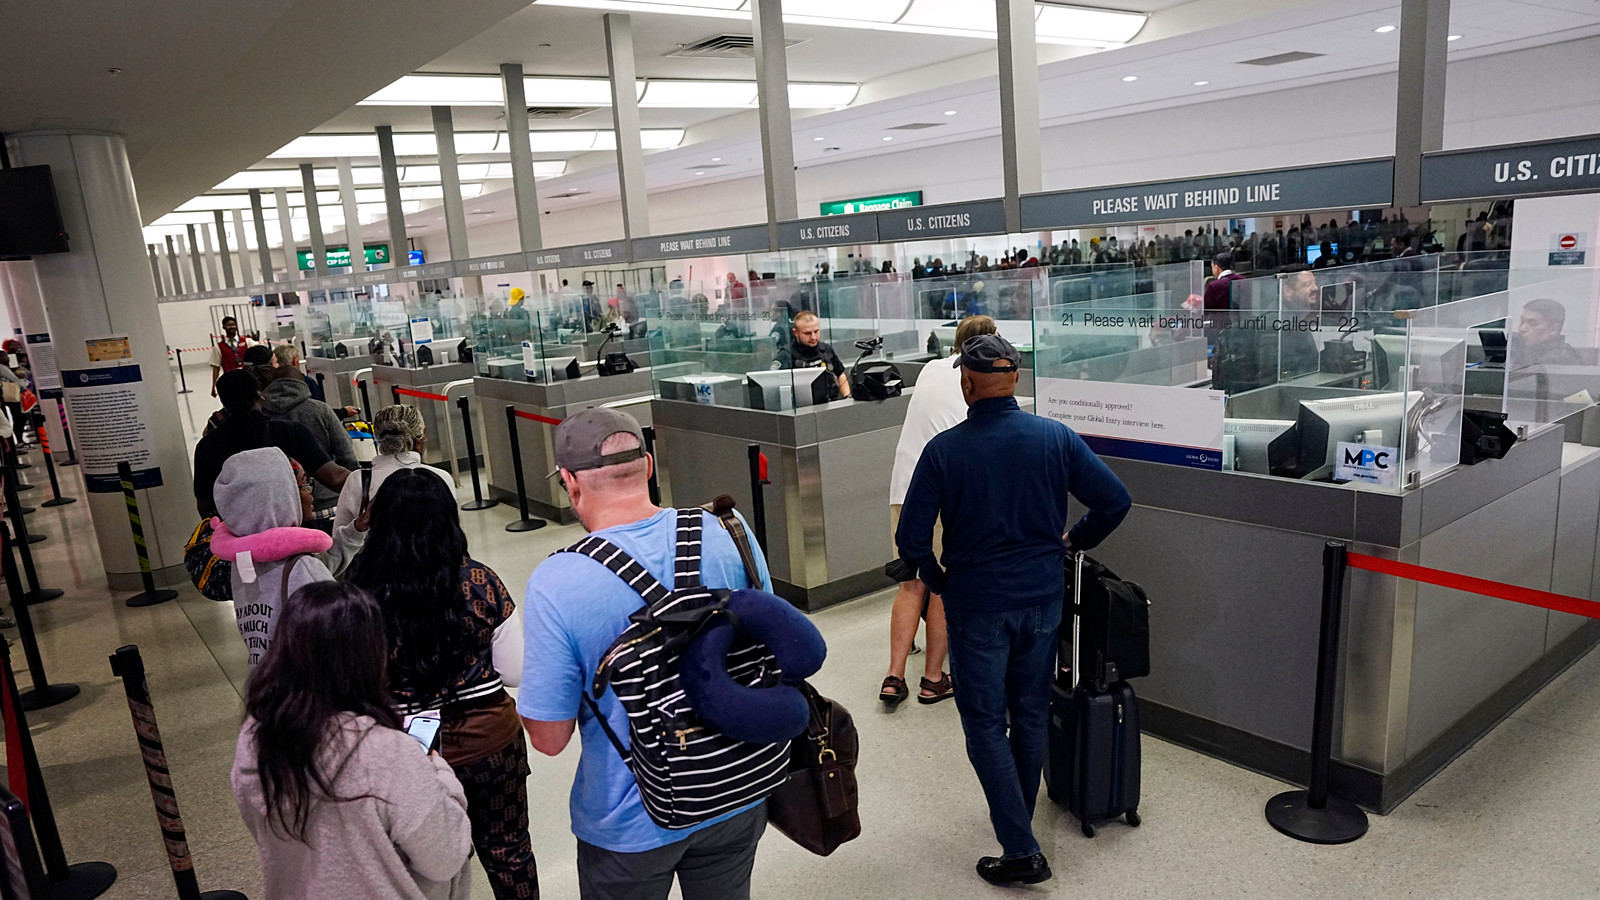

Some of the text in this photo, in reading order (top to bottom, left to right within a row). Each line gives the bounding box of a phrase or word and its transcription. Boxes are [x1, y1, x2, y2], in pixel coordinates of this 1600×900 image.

[1494, 160, 1538, 183] U.S.
[891, 199, 912, 209] Claim
[1092, 183, 1280, 215] PLEASE WAIT BEHIND LINE
[907, 213, 970, 231] U.S. CITIZENS
[800, 224, 850, 240] U.S. CITIZENS
[660, 235, 731, 252] PLEASE WAIT BEHIND LINE
[1061, 312, 1074, 326] 21
[1084, 312, 1124, 328] Please
[1128, 313, 1154, 328] wait
[1159, 313, 1204, 330] behind
[1238, 315, 1267, 331] until
[1272, 315, 1323, 333] called.
[1338, 316, 1359, 333] 22
[1047, 396, 1133, 411] Are you conditionally approved?
[1047, 410, 1073, 420] Complete
[1087, 414, 1105, 423] Global
[1105, 416, 1121, 427] Entry
[1122, 419, 1150, 428] interview
[1150, 420, 1166, 430] here.
[1344, 447, 1390, 469] MPC
[243, 603, 273, 618] ABOUT
[243, 619, 268, 634] MUCH
